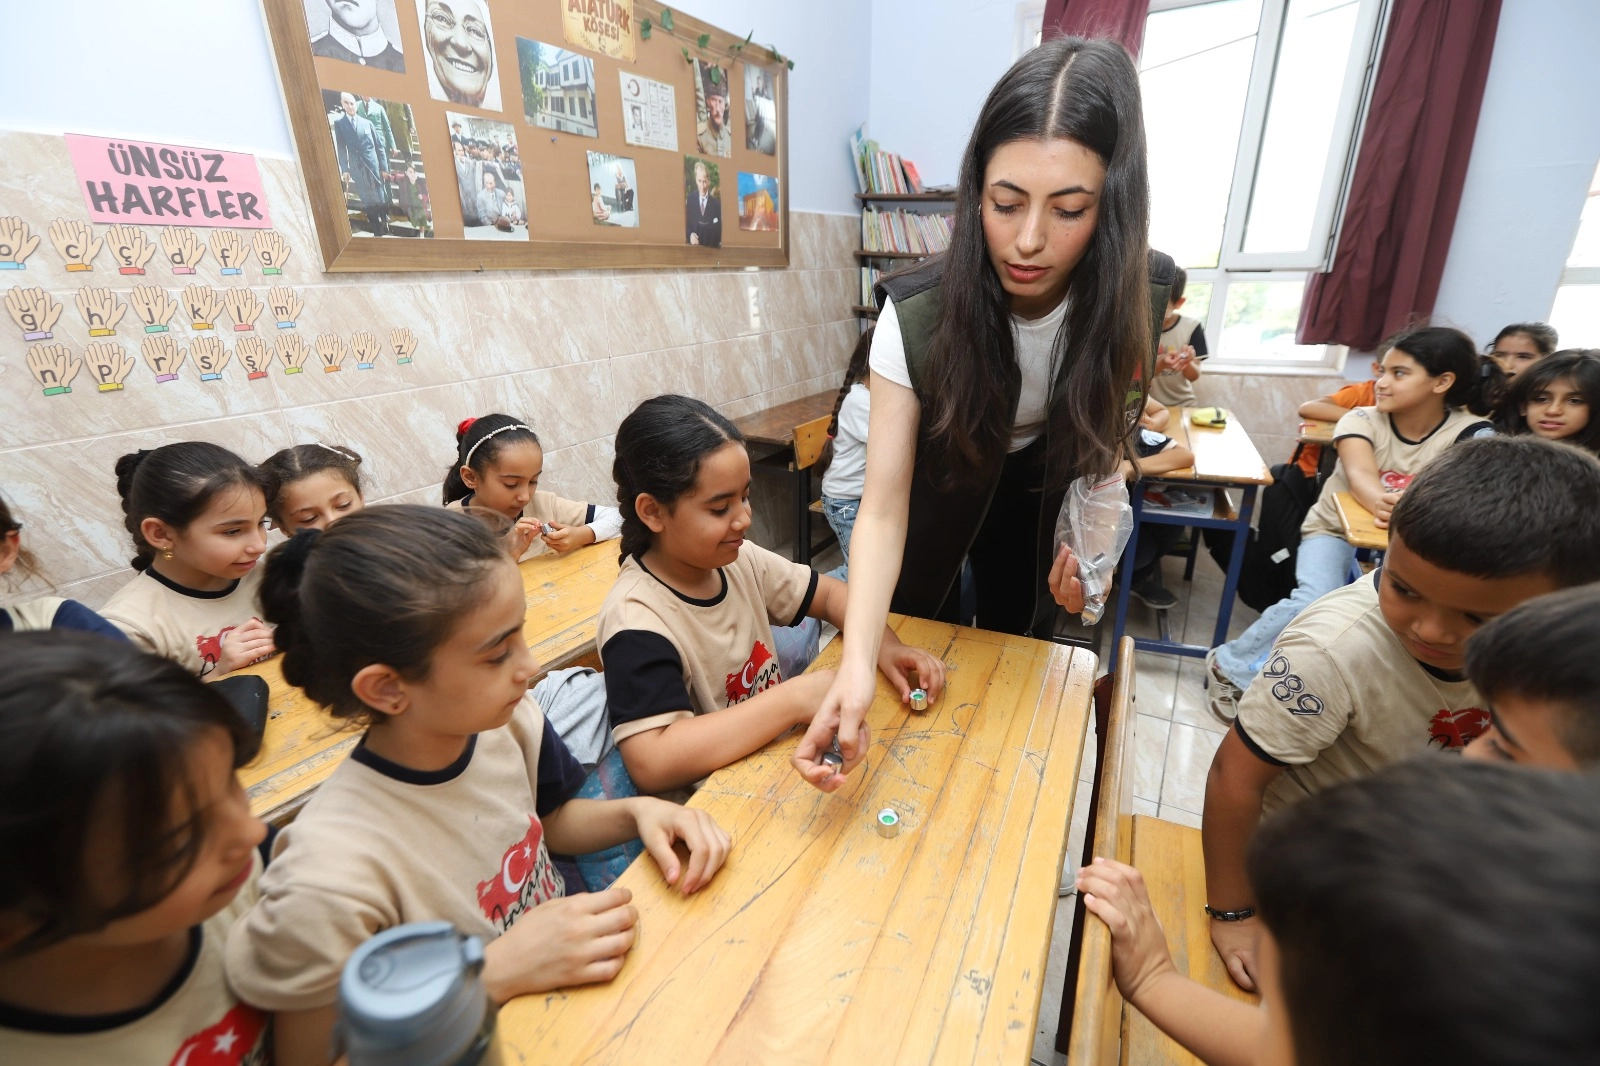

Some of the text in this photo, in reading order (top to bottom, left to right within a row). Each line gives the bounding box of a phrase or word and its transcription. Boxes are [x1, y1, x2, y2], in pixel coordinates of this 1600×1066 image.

[107, 142, 228, 183] ÜNSÜZ
[85, 180, 264, 221] HARFLER
[65, 244, 273, 267] c ç d f g
[19, 302, 289, 332] ğ h j k l m
[40, 344, 406, 383] n p r s ş t v y z
